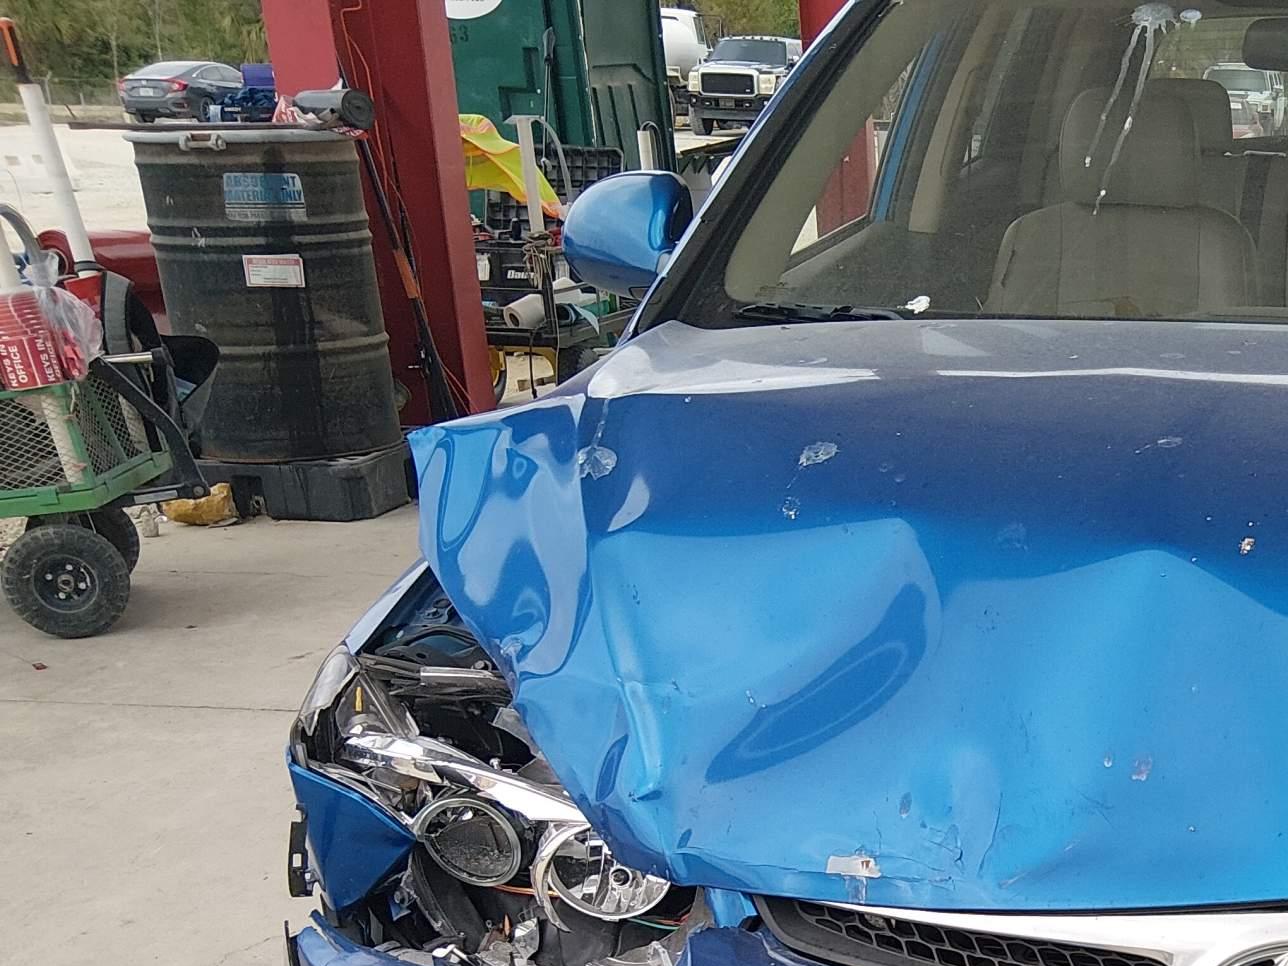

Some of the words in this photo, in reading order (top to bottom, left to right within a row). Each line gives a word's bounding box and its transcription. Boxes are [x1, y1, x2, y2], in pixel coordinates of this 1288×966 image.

[3, 359, 19, 387] KEYS
[8, 345, 29, 384] OFFICE
[40, 354, 56, 382] KEYS
